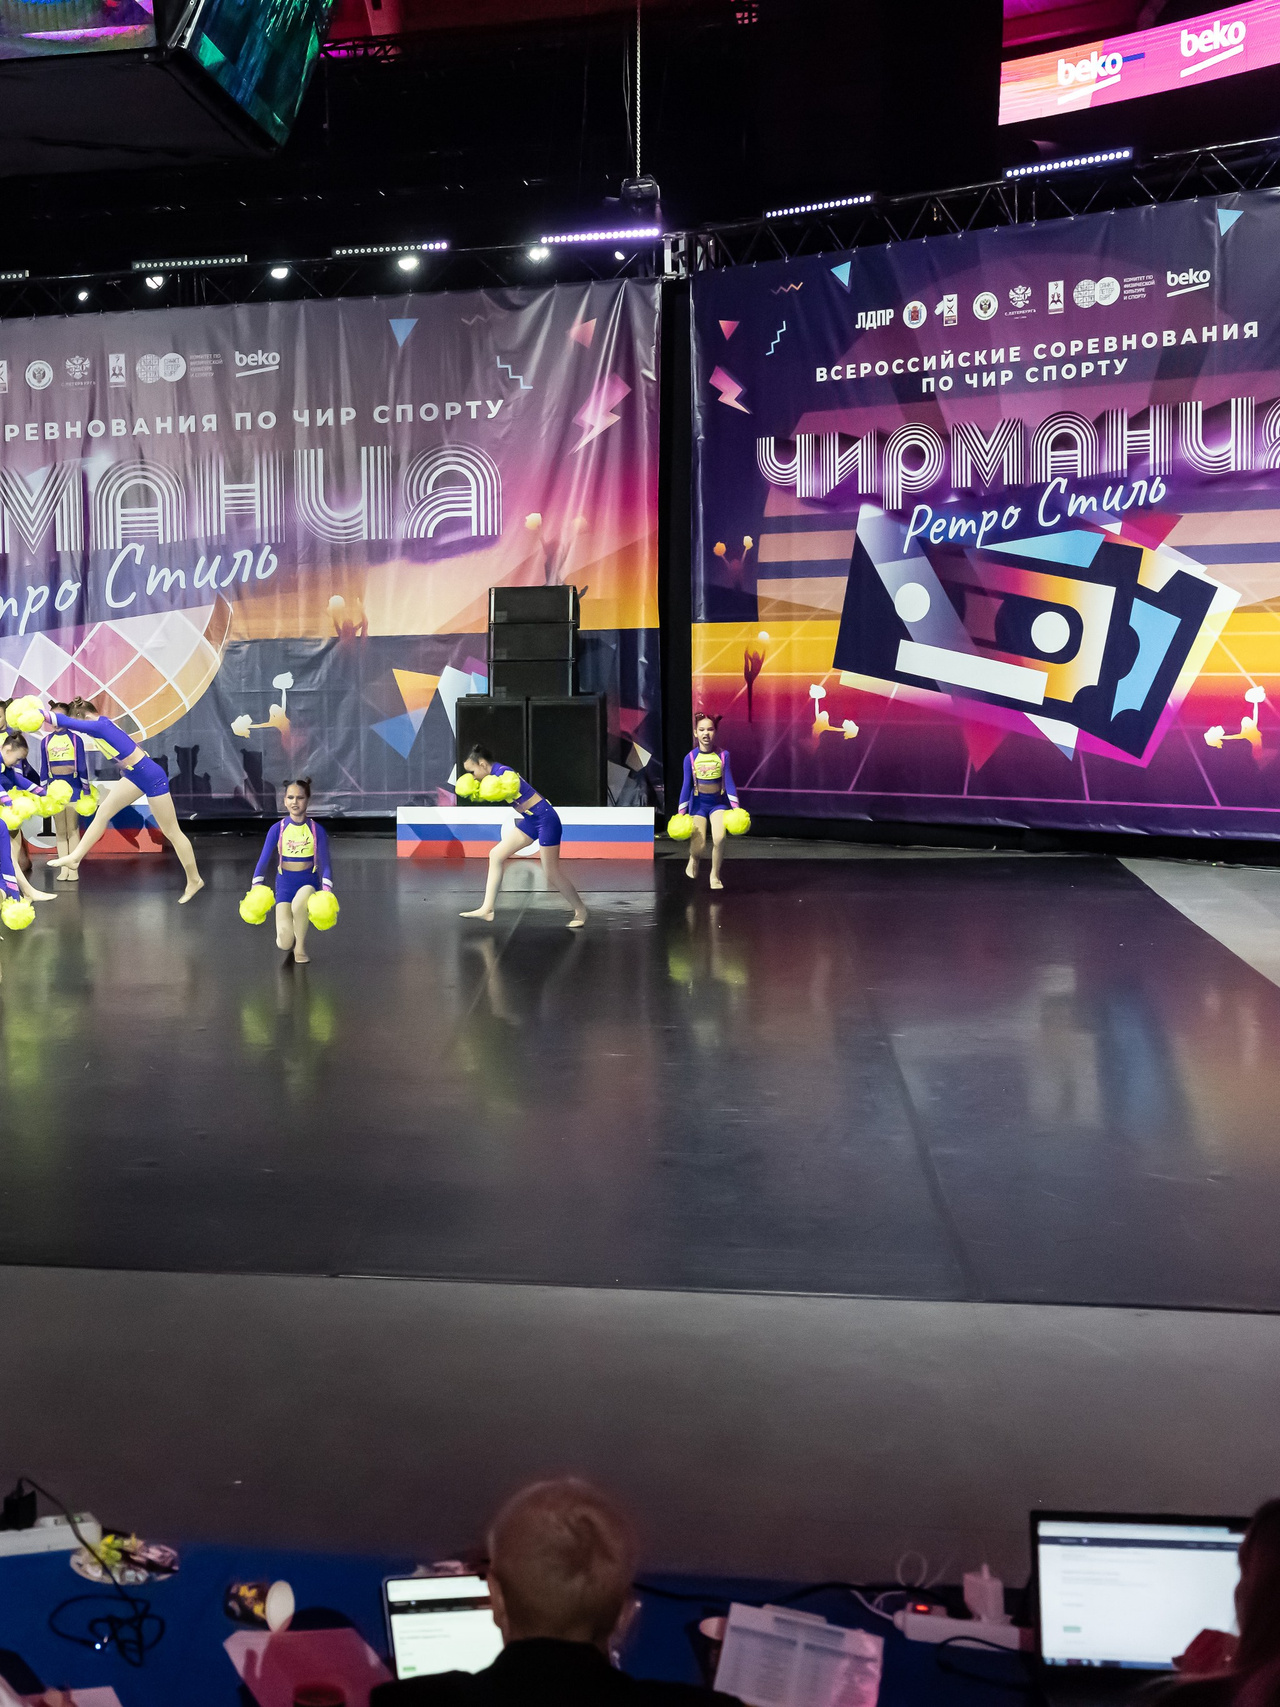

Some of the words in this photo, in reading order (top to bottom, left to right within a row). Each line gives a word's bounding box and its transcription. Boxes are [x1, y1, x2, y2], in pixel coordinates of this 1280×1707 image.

[1180, 20, 1246, 57] beko
[1057, 51, 1123, 86] beko
[1166, 268, 1211, 286] beko
[854, 308, 895, 330] ЛДПР
[235, 350, 281, 366] beko
[815, 346, 1021, 382] ВСЕРОССИЙСКИЕ
[1033, 321, 1258, 360] СОРЕВНОВАНИЯ
[922, 375, 954, 393] ПО
[965, 370, 1014, 388] ЧИР
[1025, 358, 1128, 383] СПОРТУ
[235, 411, 277, 431] ПО
[293, 407, 356, 427] ЧИР
[373, 399, 504, 424] СПОРТУ
[903, 504, 1021, 554] Ретро
[1038, 476, 1167, 527] Стиль
[105, 543, 278, 608] Стиль
